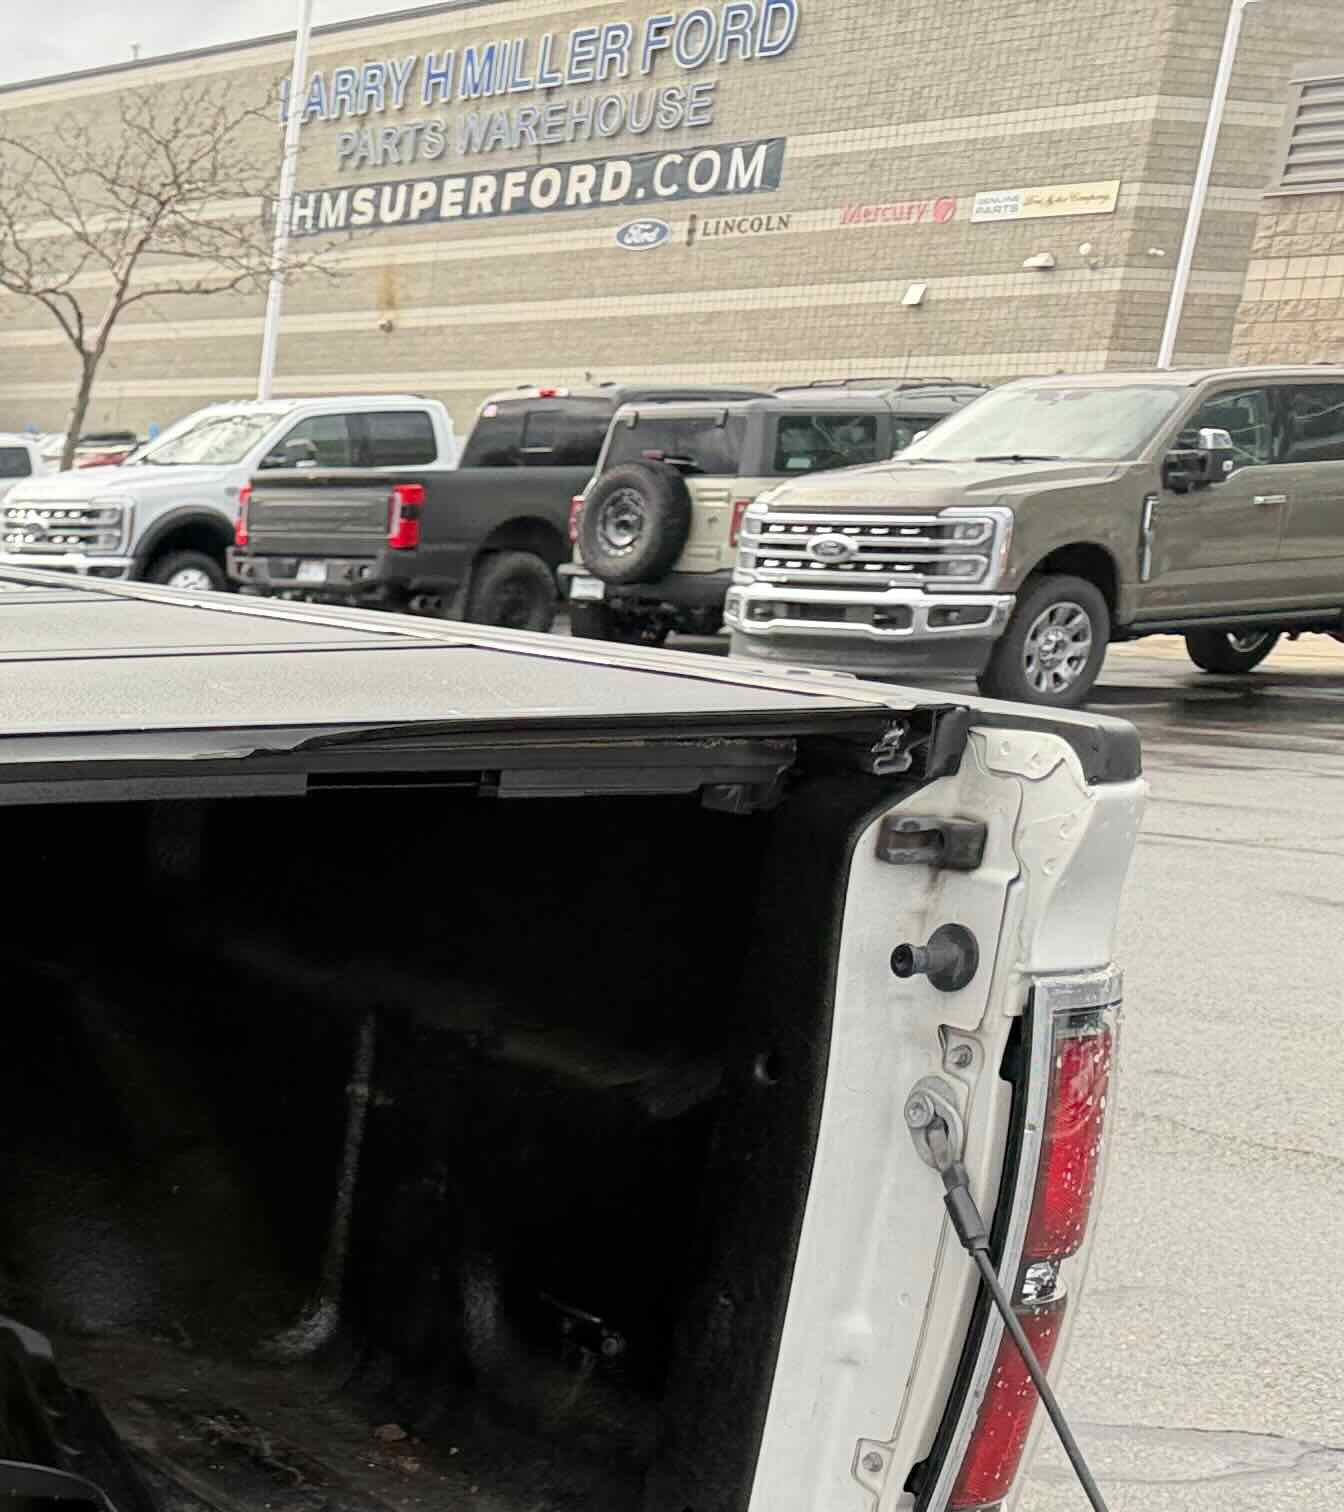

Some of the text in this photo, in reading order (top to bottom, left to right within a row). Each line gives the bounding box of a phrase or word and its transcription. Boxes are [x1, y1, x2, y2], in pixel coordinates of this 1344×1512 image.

[421, 48, 454, 106] H
[459, 22, 632, 101] MILLER
[639, 0, 798, 75] FORD
[334, 81, 716, 171] PARTS WAREHOUSE
[702, 213, 792, 236] LINCOLN
